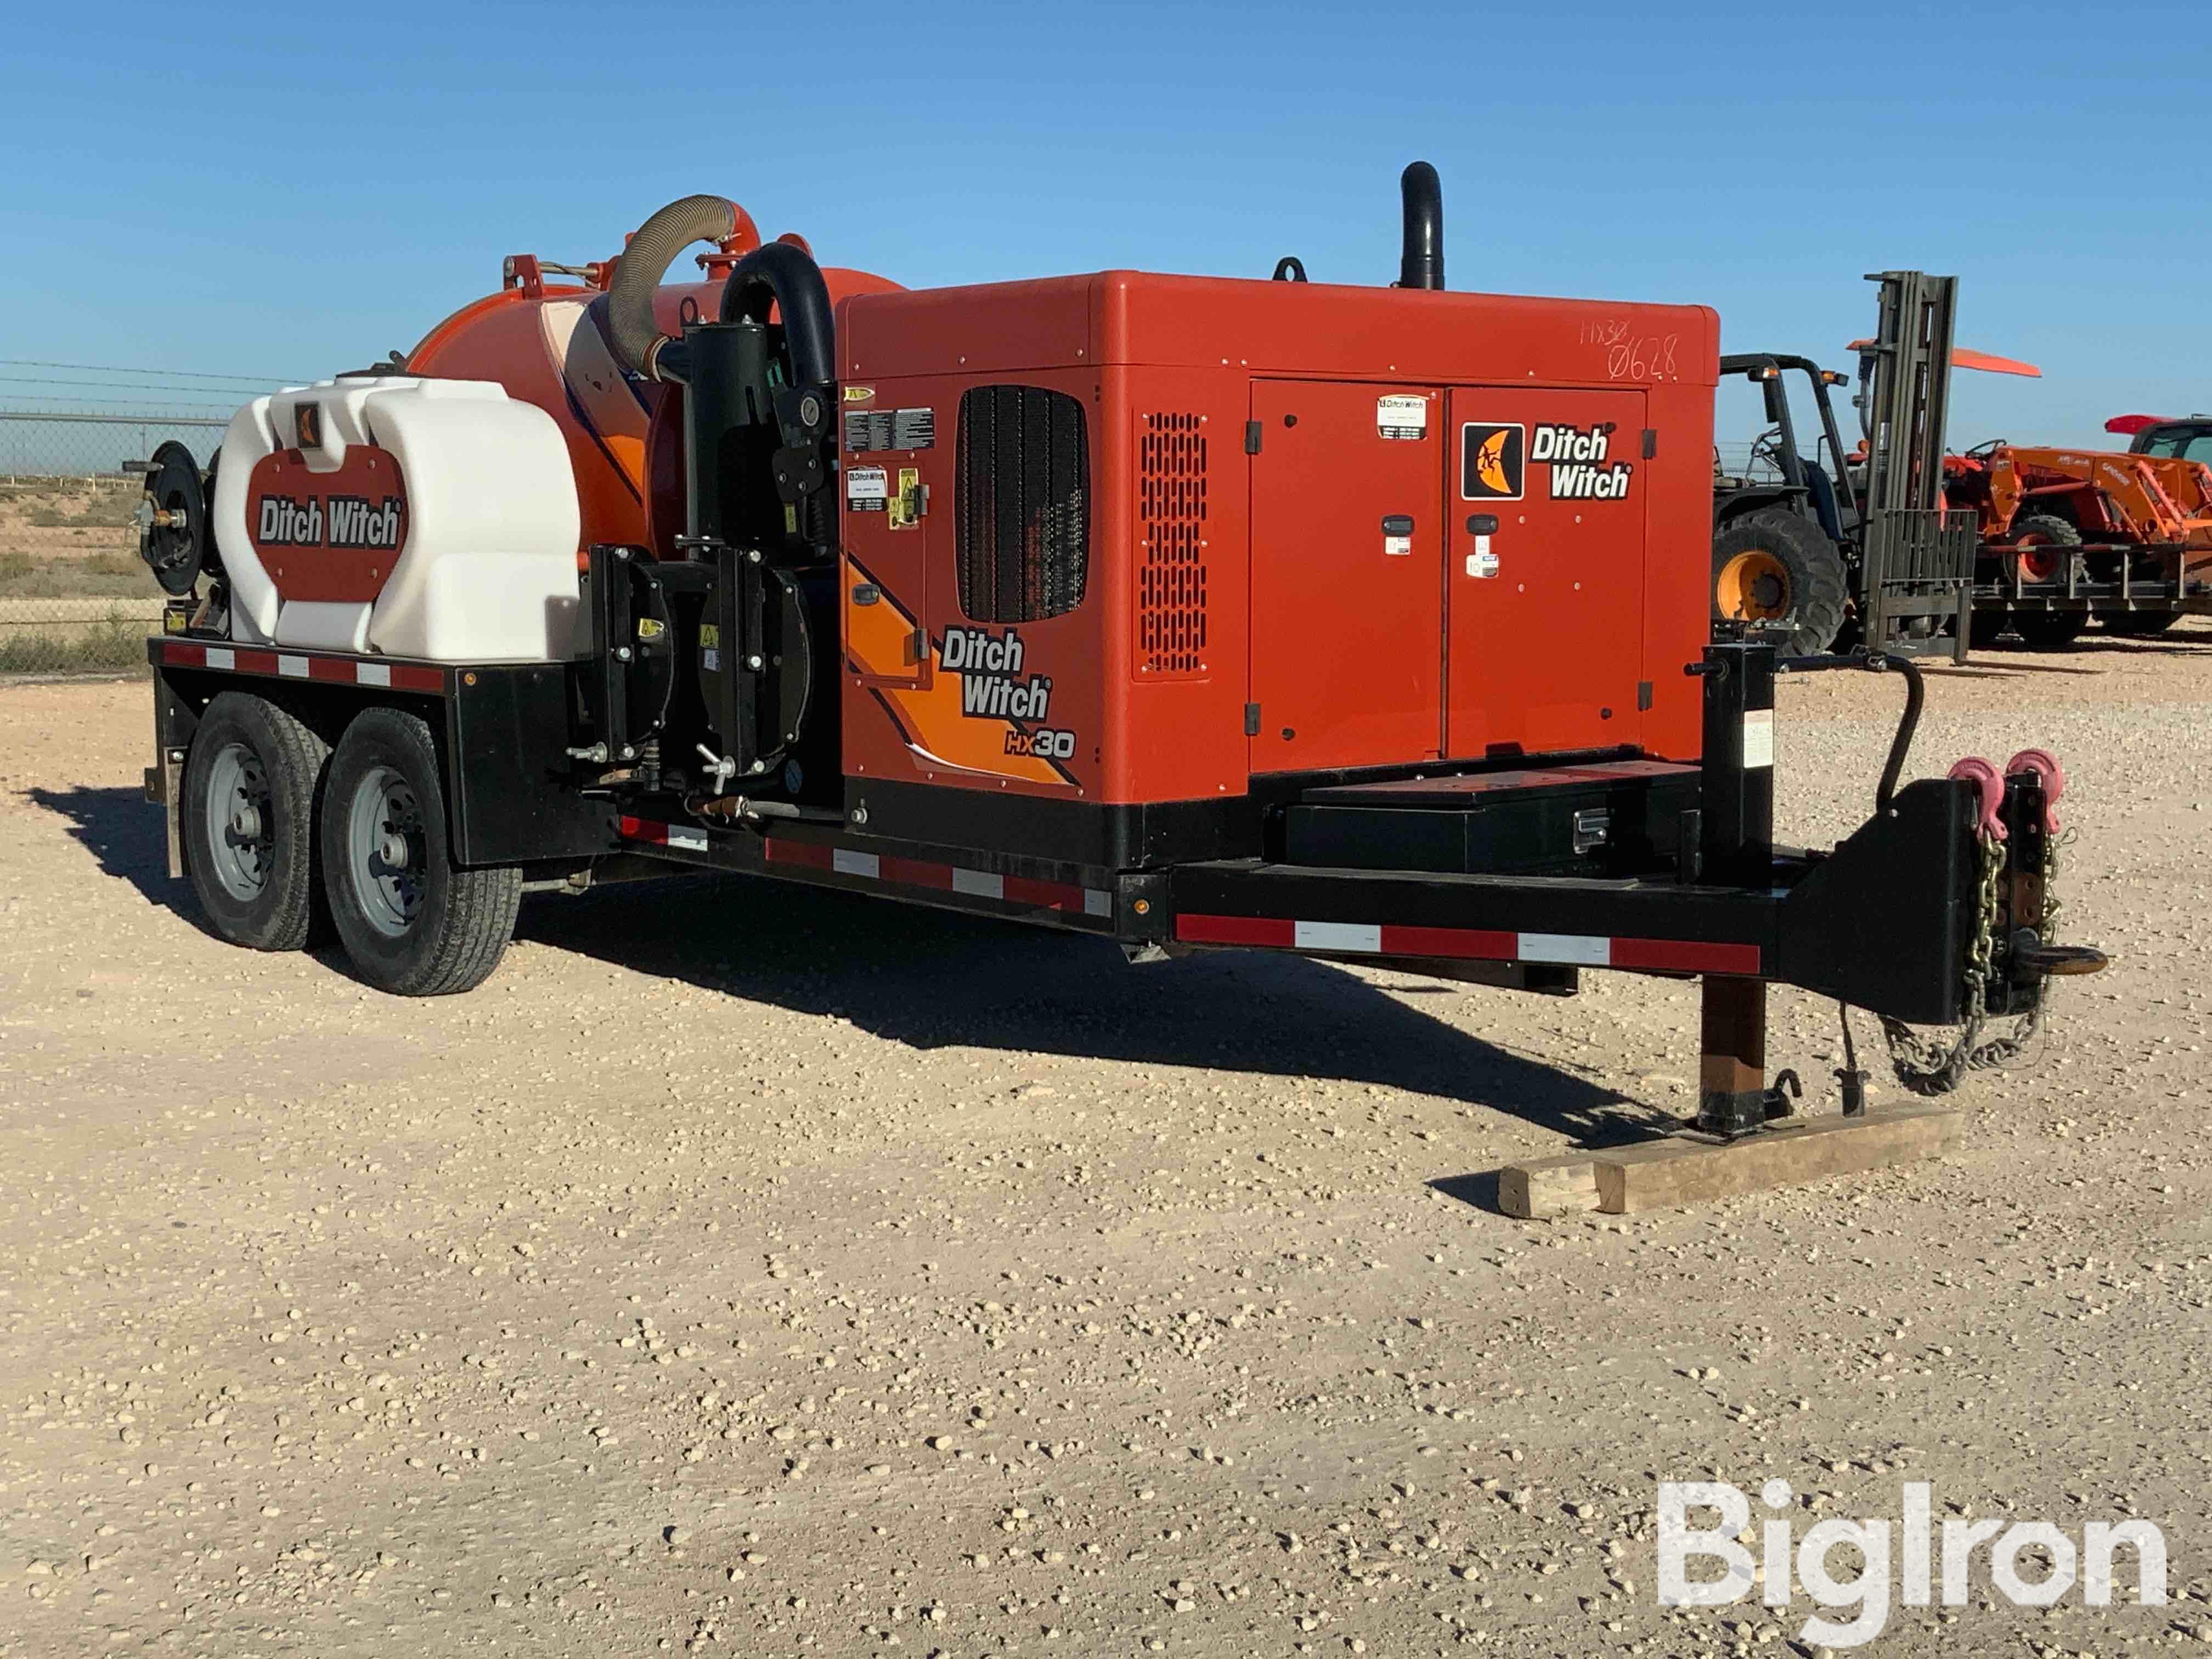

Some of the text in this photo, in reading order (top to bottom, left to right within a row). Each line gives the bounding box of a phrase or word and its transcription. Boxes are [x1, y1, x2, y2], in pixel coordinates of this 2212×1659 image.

[1532, 427, 1607, 460] Ditch
[1551, 465, 1629, 498] Witch
[259, 499, 399, 545] Ditch Witch
[943, 629, 1022, 671] Ditch
[964, 675, 1049, 718] Witch
[1006, 731, 1075, 758] HX30
